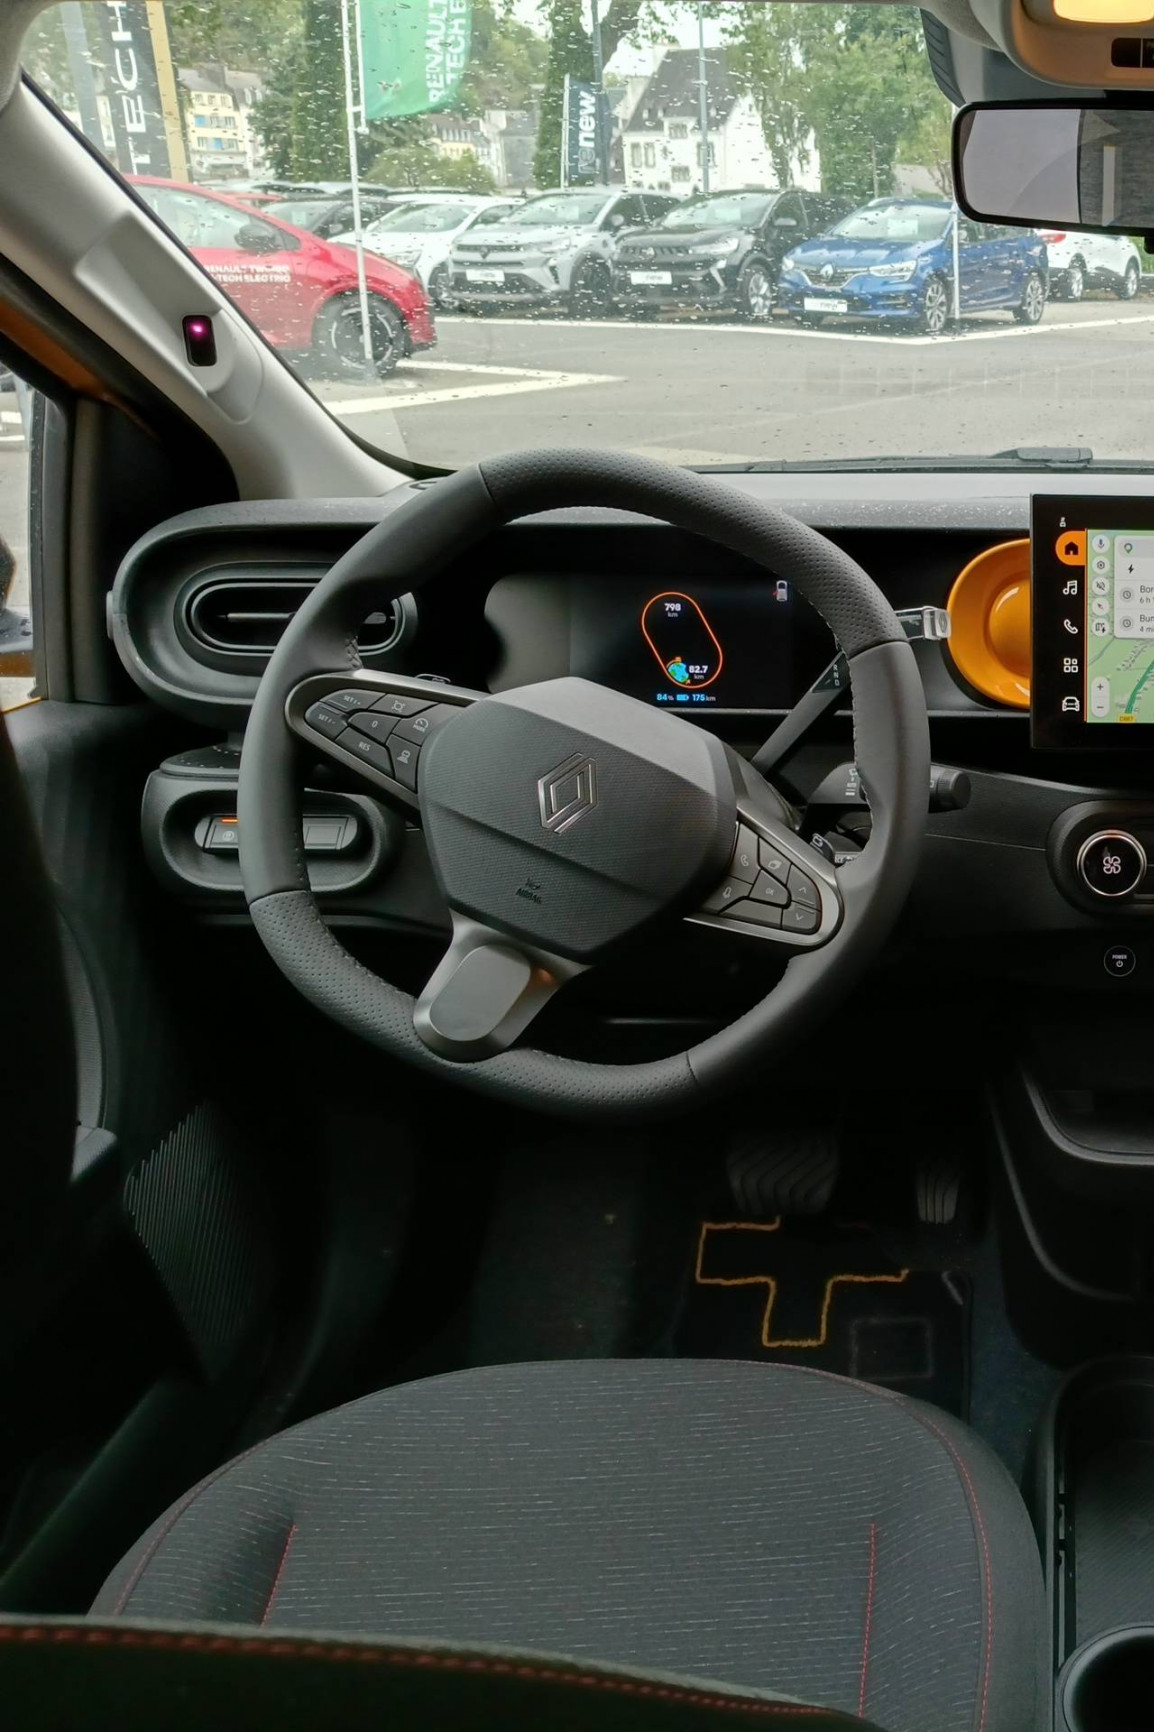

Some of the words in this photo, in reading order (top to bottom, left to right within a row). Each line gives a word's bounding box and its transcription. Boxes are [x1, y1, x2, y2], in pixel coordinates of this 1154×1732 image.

[446, 18, 466, 85] TECH
[107, 0, 150, 176] TECH
[578, 91, 596, 174] renew
[664, 603, 682, 612] 798
[688, 665, 709, 674] 82.7
[358, 741, 372, 752] RES
